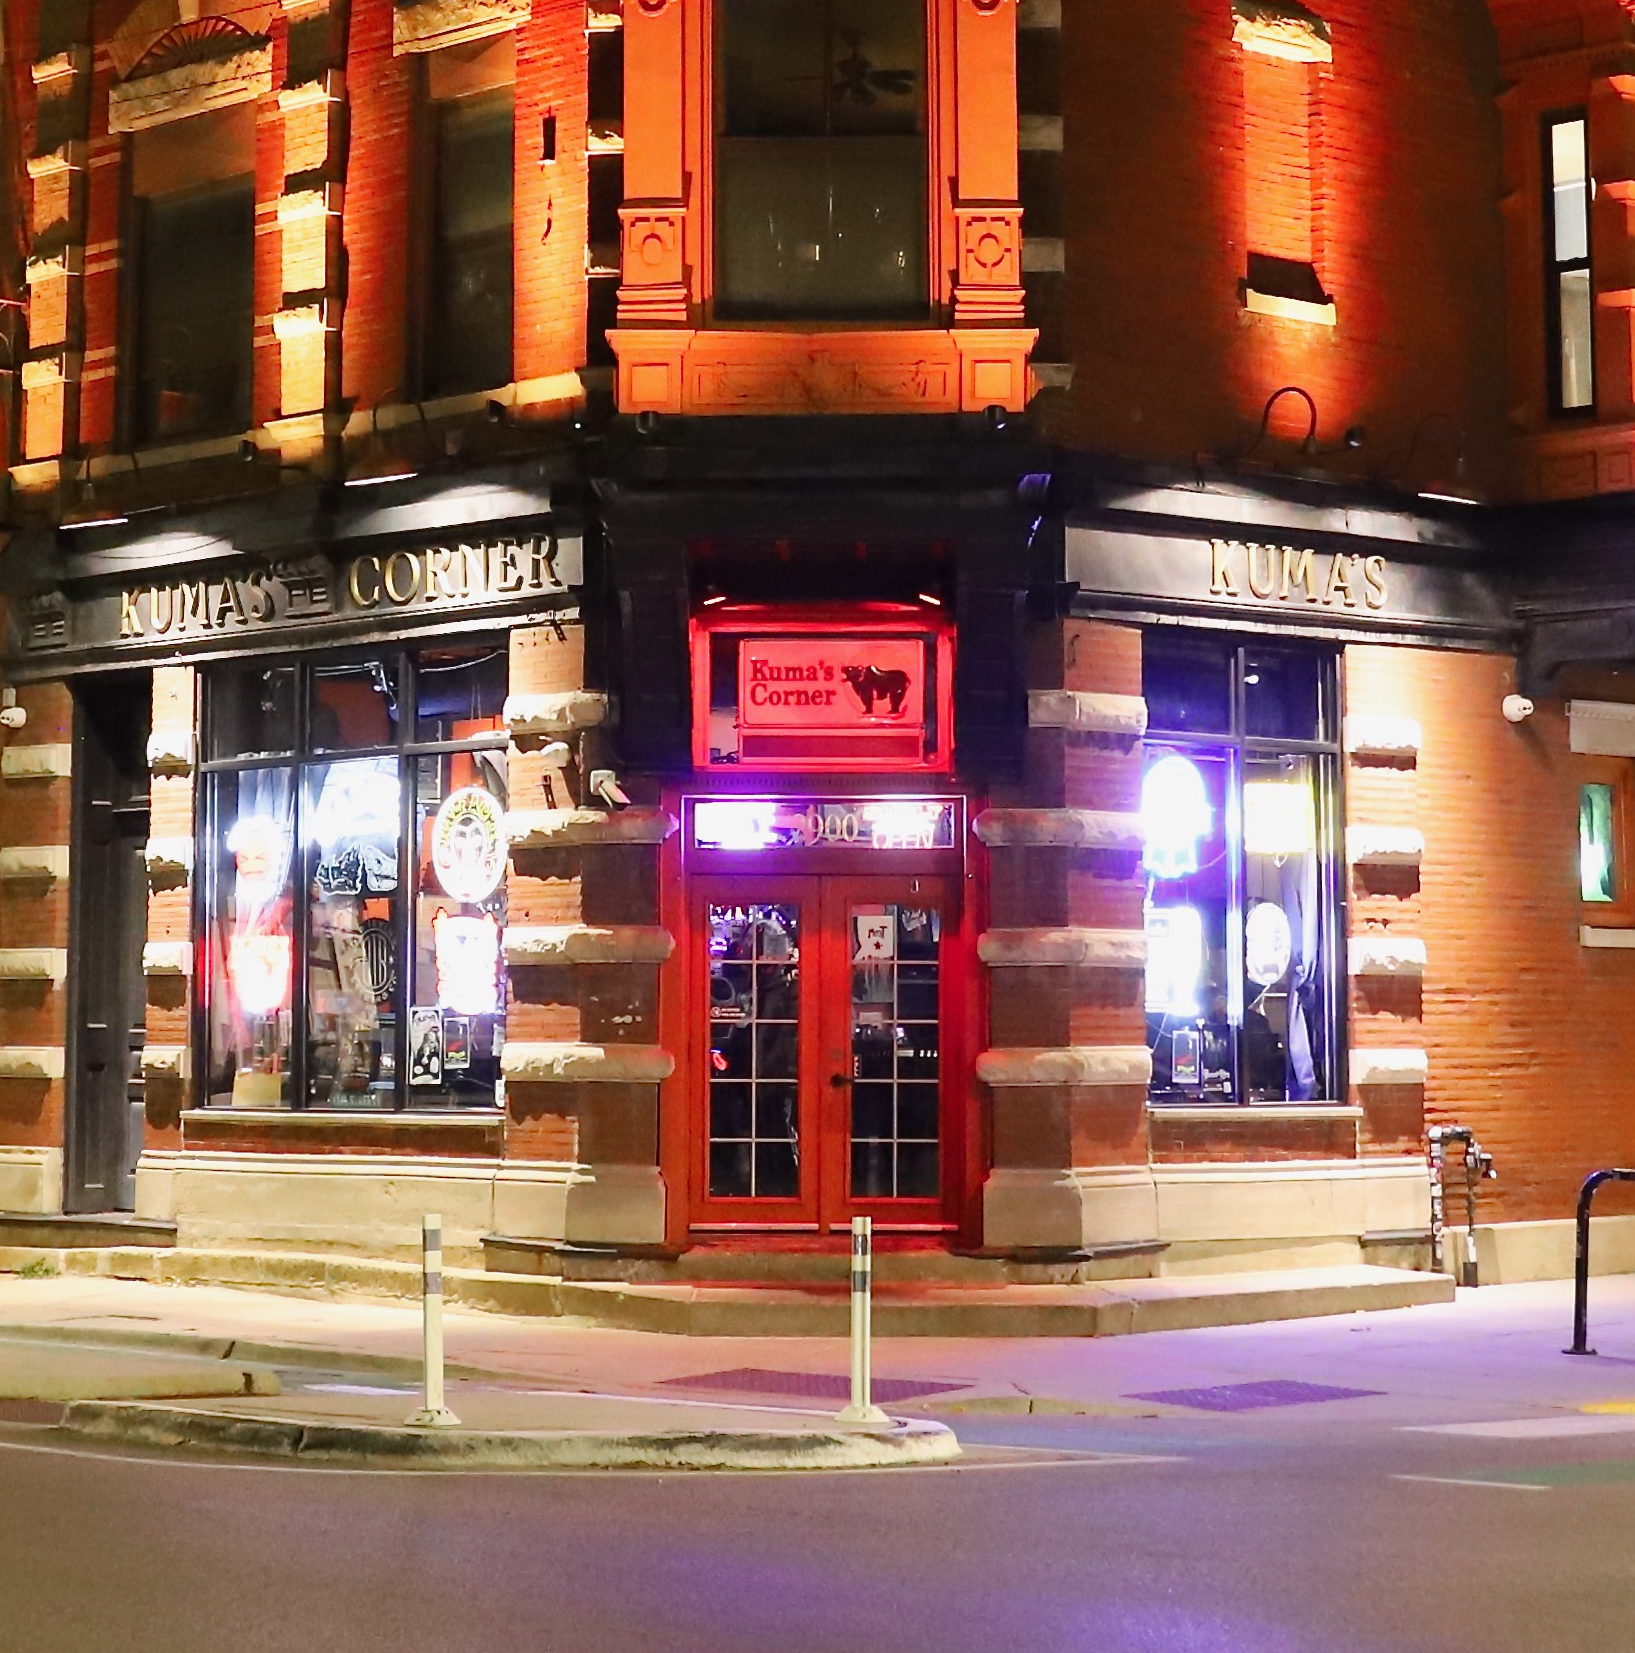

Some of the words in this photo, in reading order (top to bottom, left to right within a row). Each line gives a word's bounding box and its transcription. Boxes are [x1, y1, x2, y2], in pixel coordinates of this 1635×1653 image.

[349, 533, 563, 609] CORNER
[1210, 539, 1388, 610] KUMA'S
[750, 659, 835, 682] Kuma's
[750, 683, 836, 706] Corner
